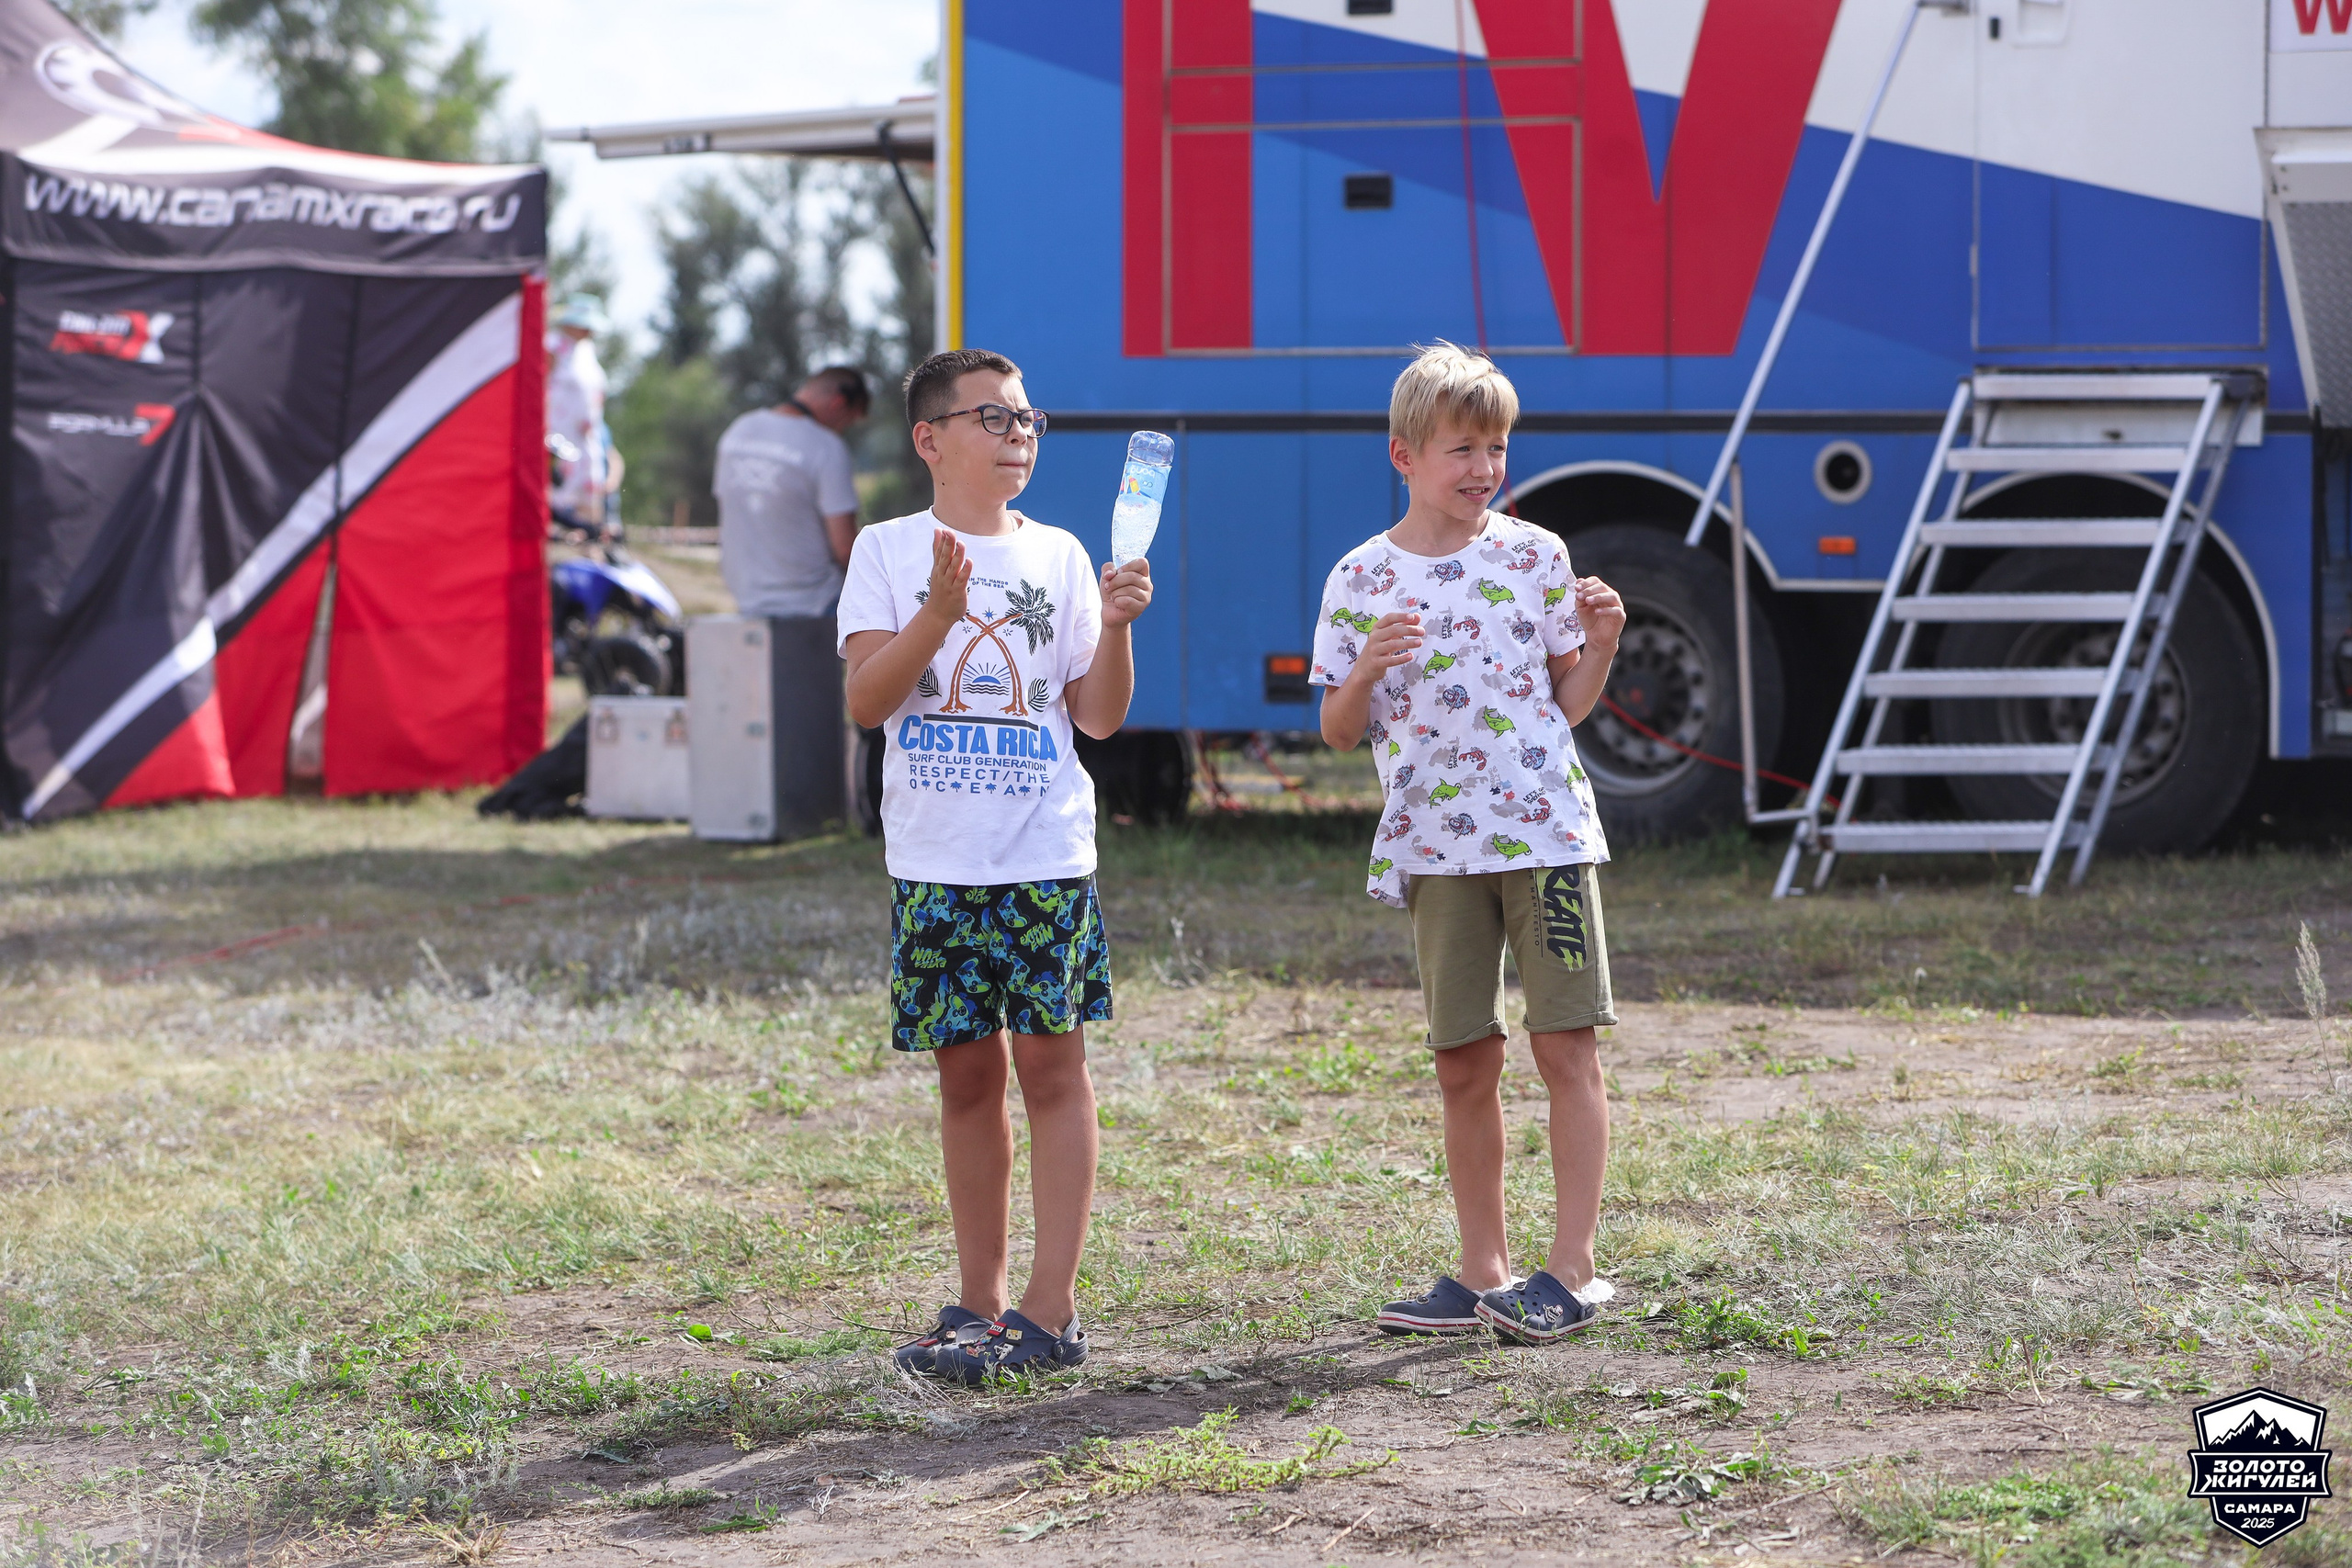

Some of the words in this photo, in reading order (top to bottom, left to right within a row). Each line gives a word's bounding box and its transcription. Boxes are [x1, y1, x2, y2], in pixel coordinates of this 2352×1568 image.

[898, 715, 989, 754] COSTA
[997, 726, 1057, 761] RICA
[908, 753, 934, 762] SURF
[937, 755, 971, 765] CLUB
[975, 758, 1046, 772] GENERATION
[1530, 886, 1541, 946] MANIFESTO
